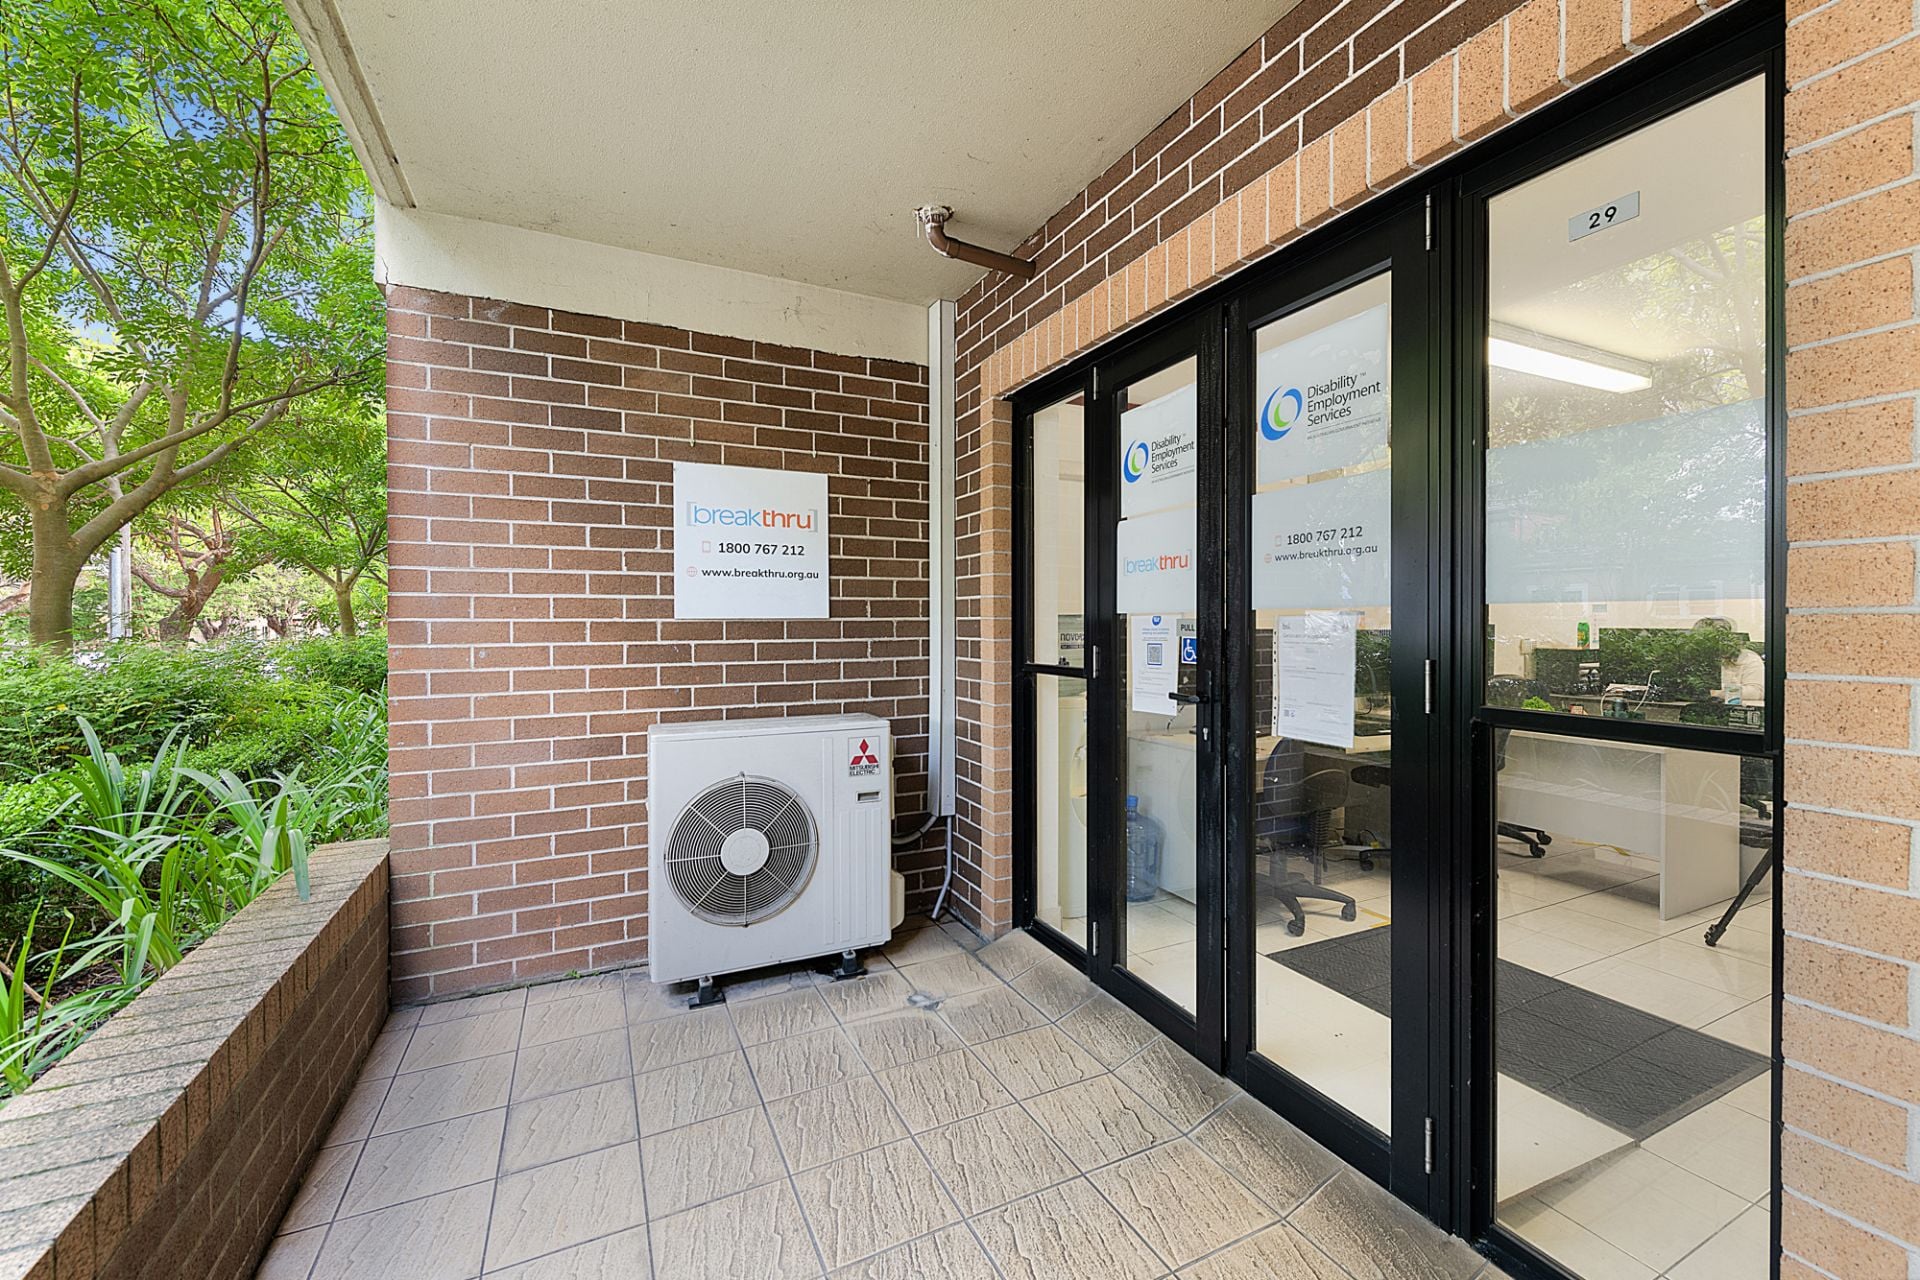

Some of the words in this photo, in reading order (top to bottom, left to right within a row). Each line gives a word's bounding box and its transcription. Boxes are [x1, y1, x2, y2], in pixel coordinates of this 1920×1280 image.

[1589, 206, 1617, 230] 29
[1307, 374, 1358, 399] Disability
[1307, 381, 1381, 413] Employment
[1307, 406, 1352, 427] Services
[1151, 434, 1182, 452] Disability
[1151, 440, 1195, 463] Employment
[1151, 459, 1178, 474] Services
[1287, 532, 1313, 546] 1800
[1316, 529, 1337, 542] 767
[1340, 525, 1363, 539] 212
[718, 542, 751, 554] 1800
[754, 543, 778, 555] 767
[782, 545, 805, 556] 212
[701, 568, 819, 581] www.breakthru.org.au
[1181, 623, 1196, 632] PULL
